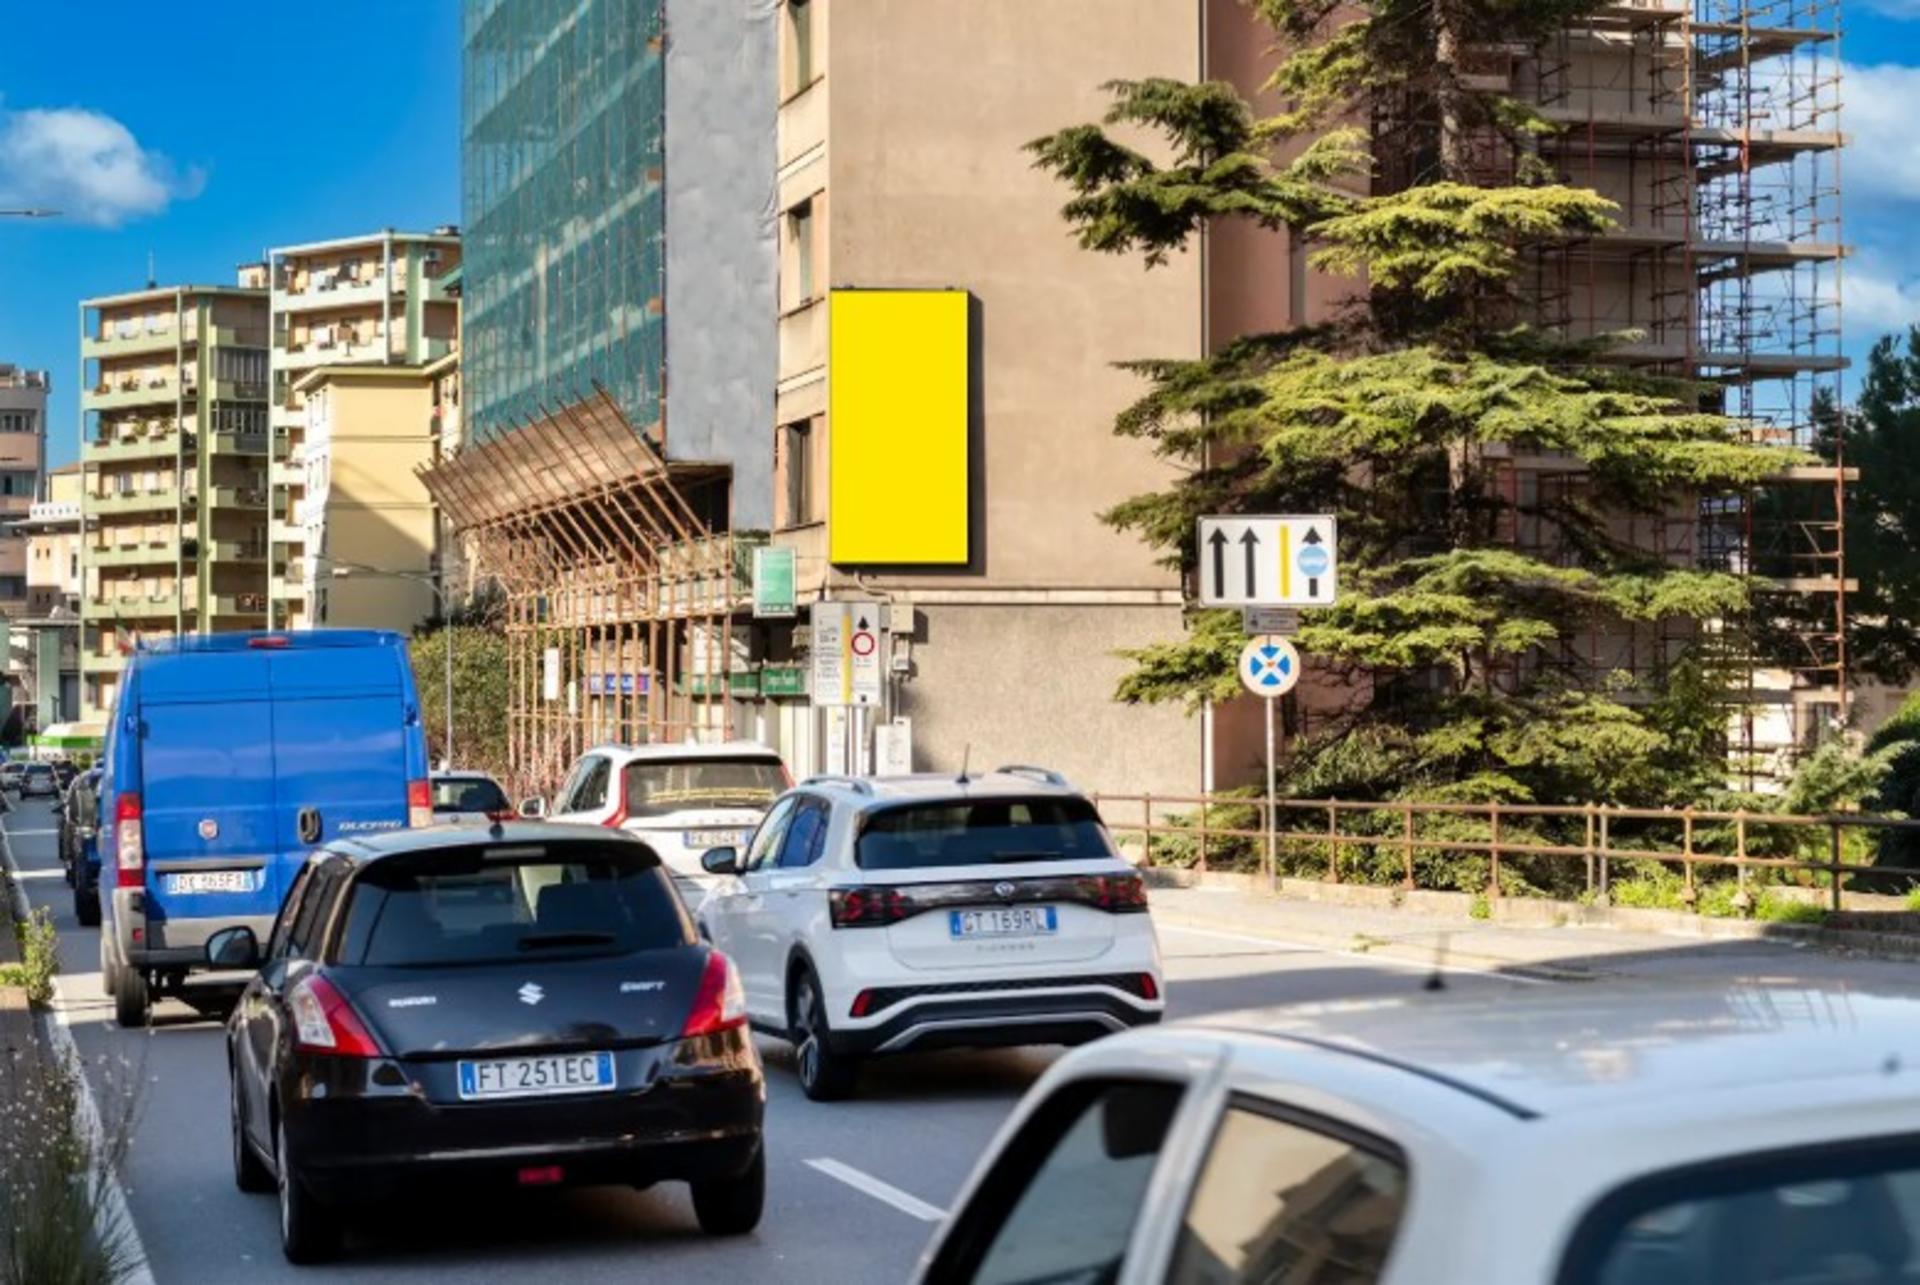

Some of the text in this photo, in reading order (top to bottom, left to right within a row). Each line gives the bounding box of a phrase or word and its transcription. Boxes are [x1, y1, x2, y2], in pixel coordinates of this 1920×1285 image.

[991, 909, 1045, 931] 169RL
[478, 1057, 595, 1088] FT 251EC
